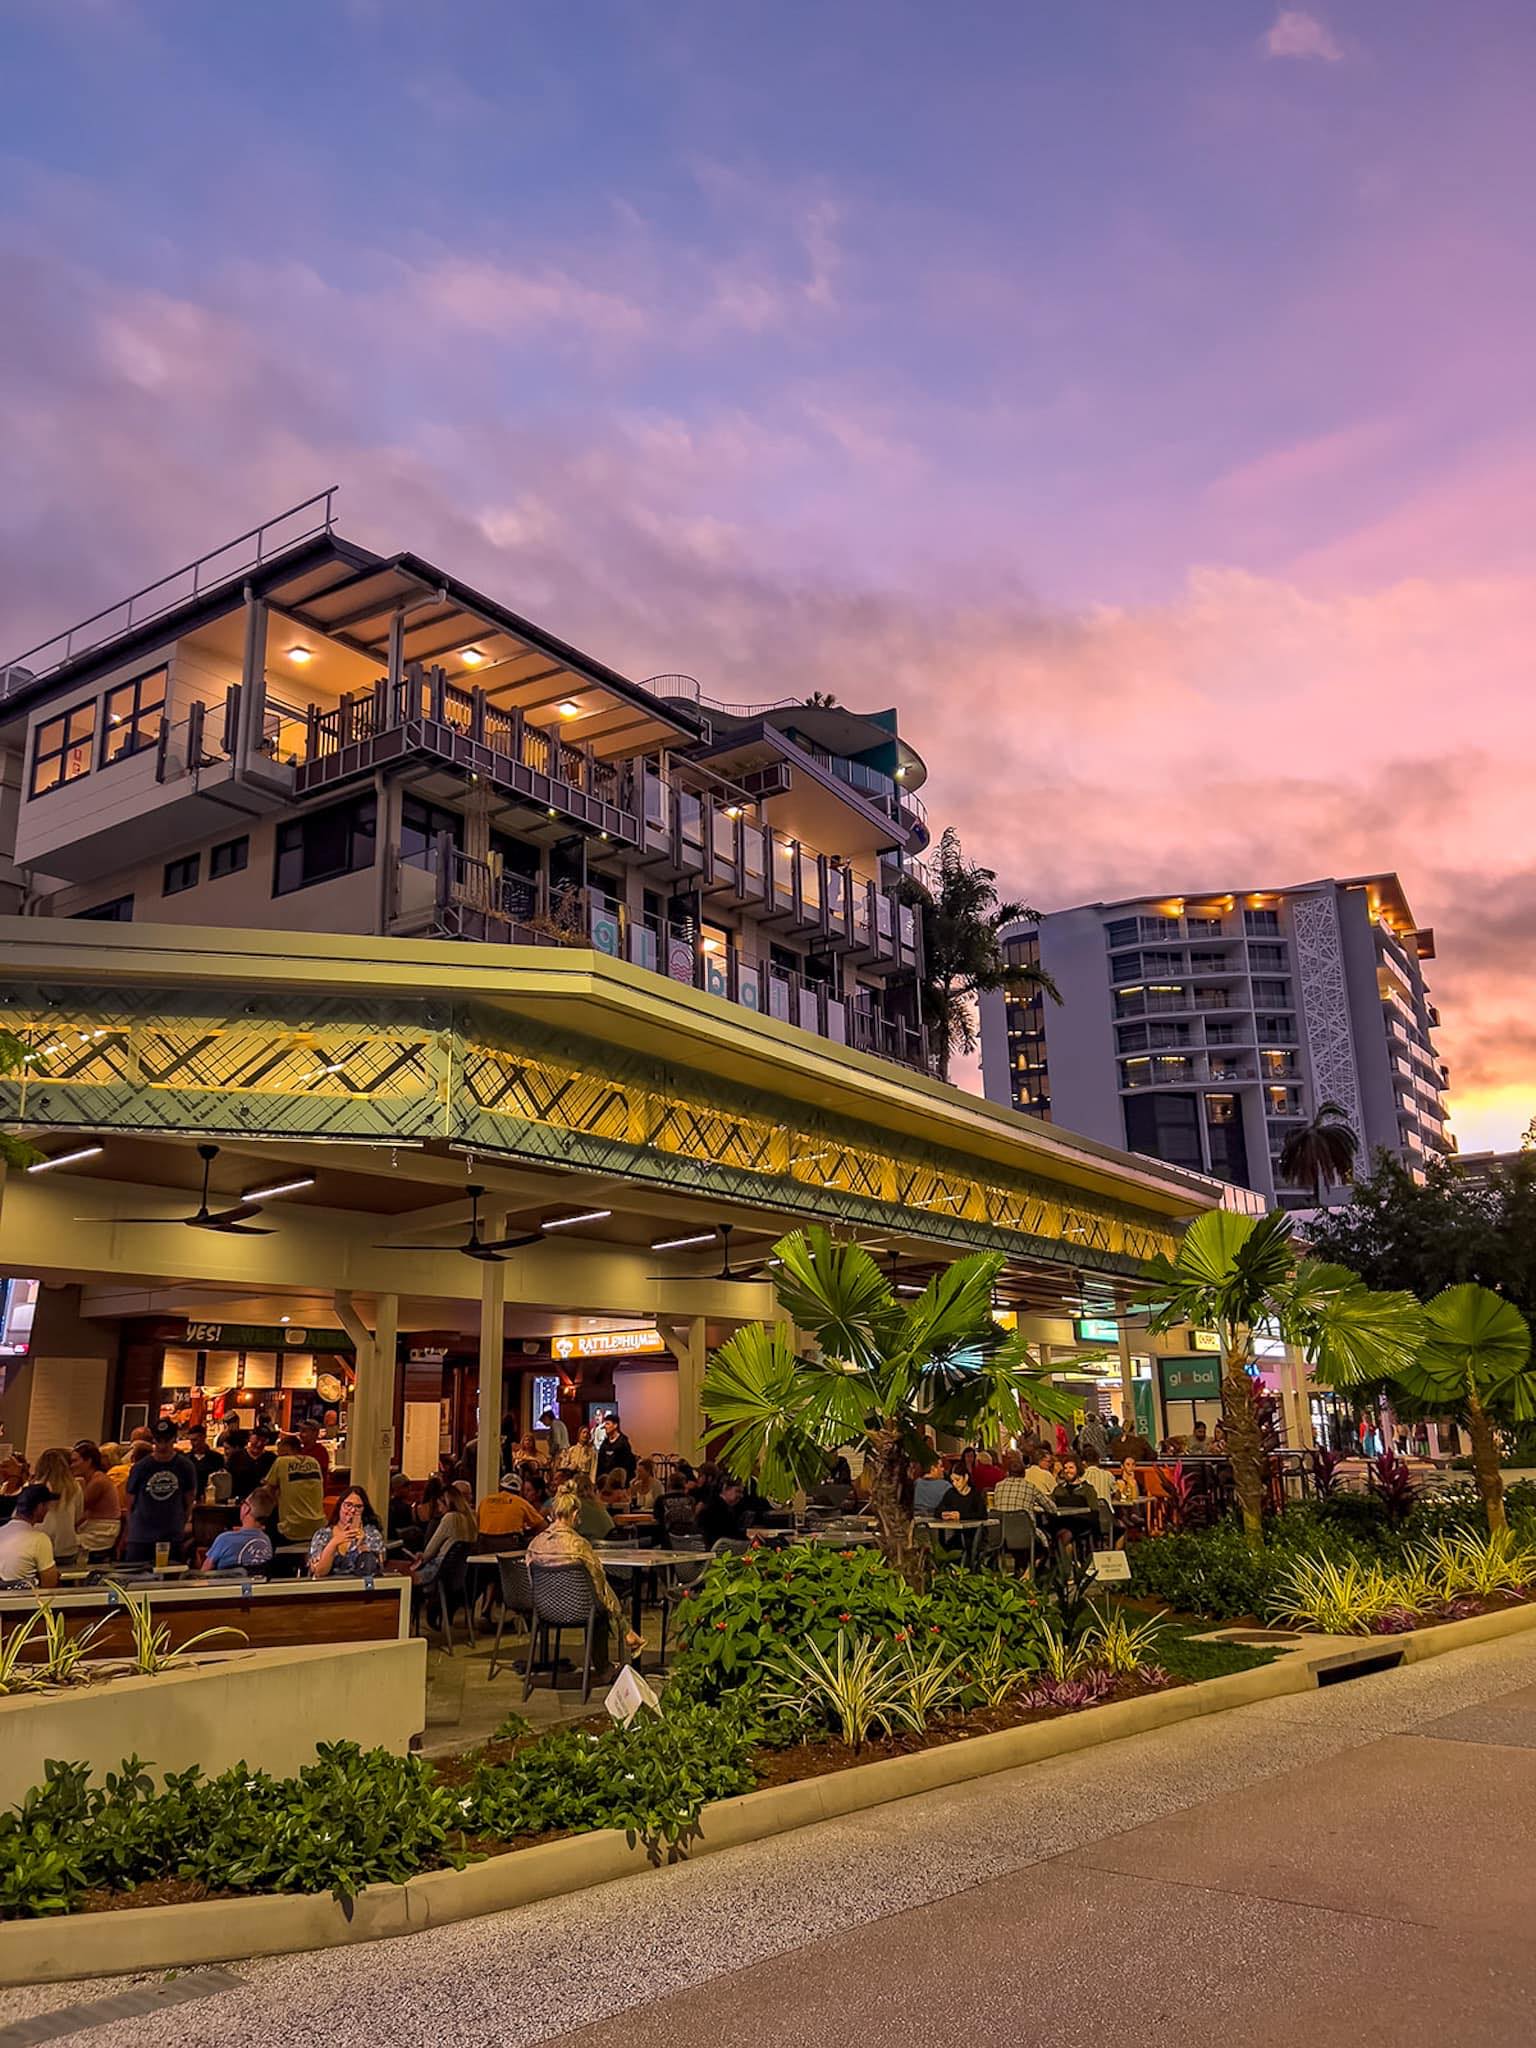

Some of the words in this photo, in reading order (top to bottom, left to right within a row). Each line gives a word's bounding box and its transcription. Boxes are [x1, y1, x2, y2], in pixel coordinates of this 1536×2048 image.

[186, 1324, 222, 1342] YES!
[578, 1336, 617, 1353] RATTLE
[622, 1333, 648, 1349] HUM
[1169, 1370, 1214, 1387] glbal
